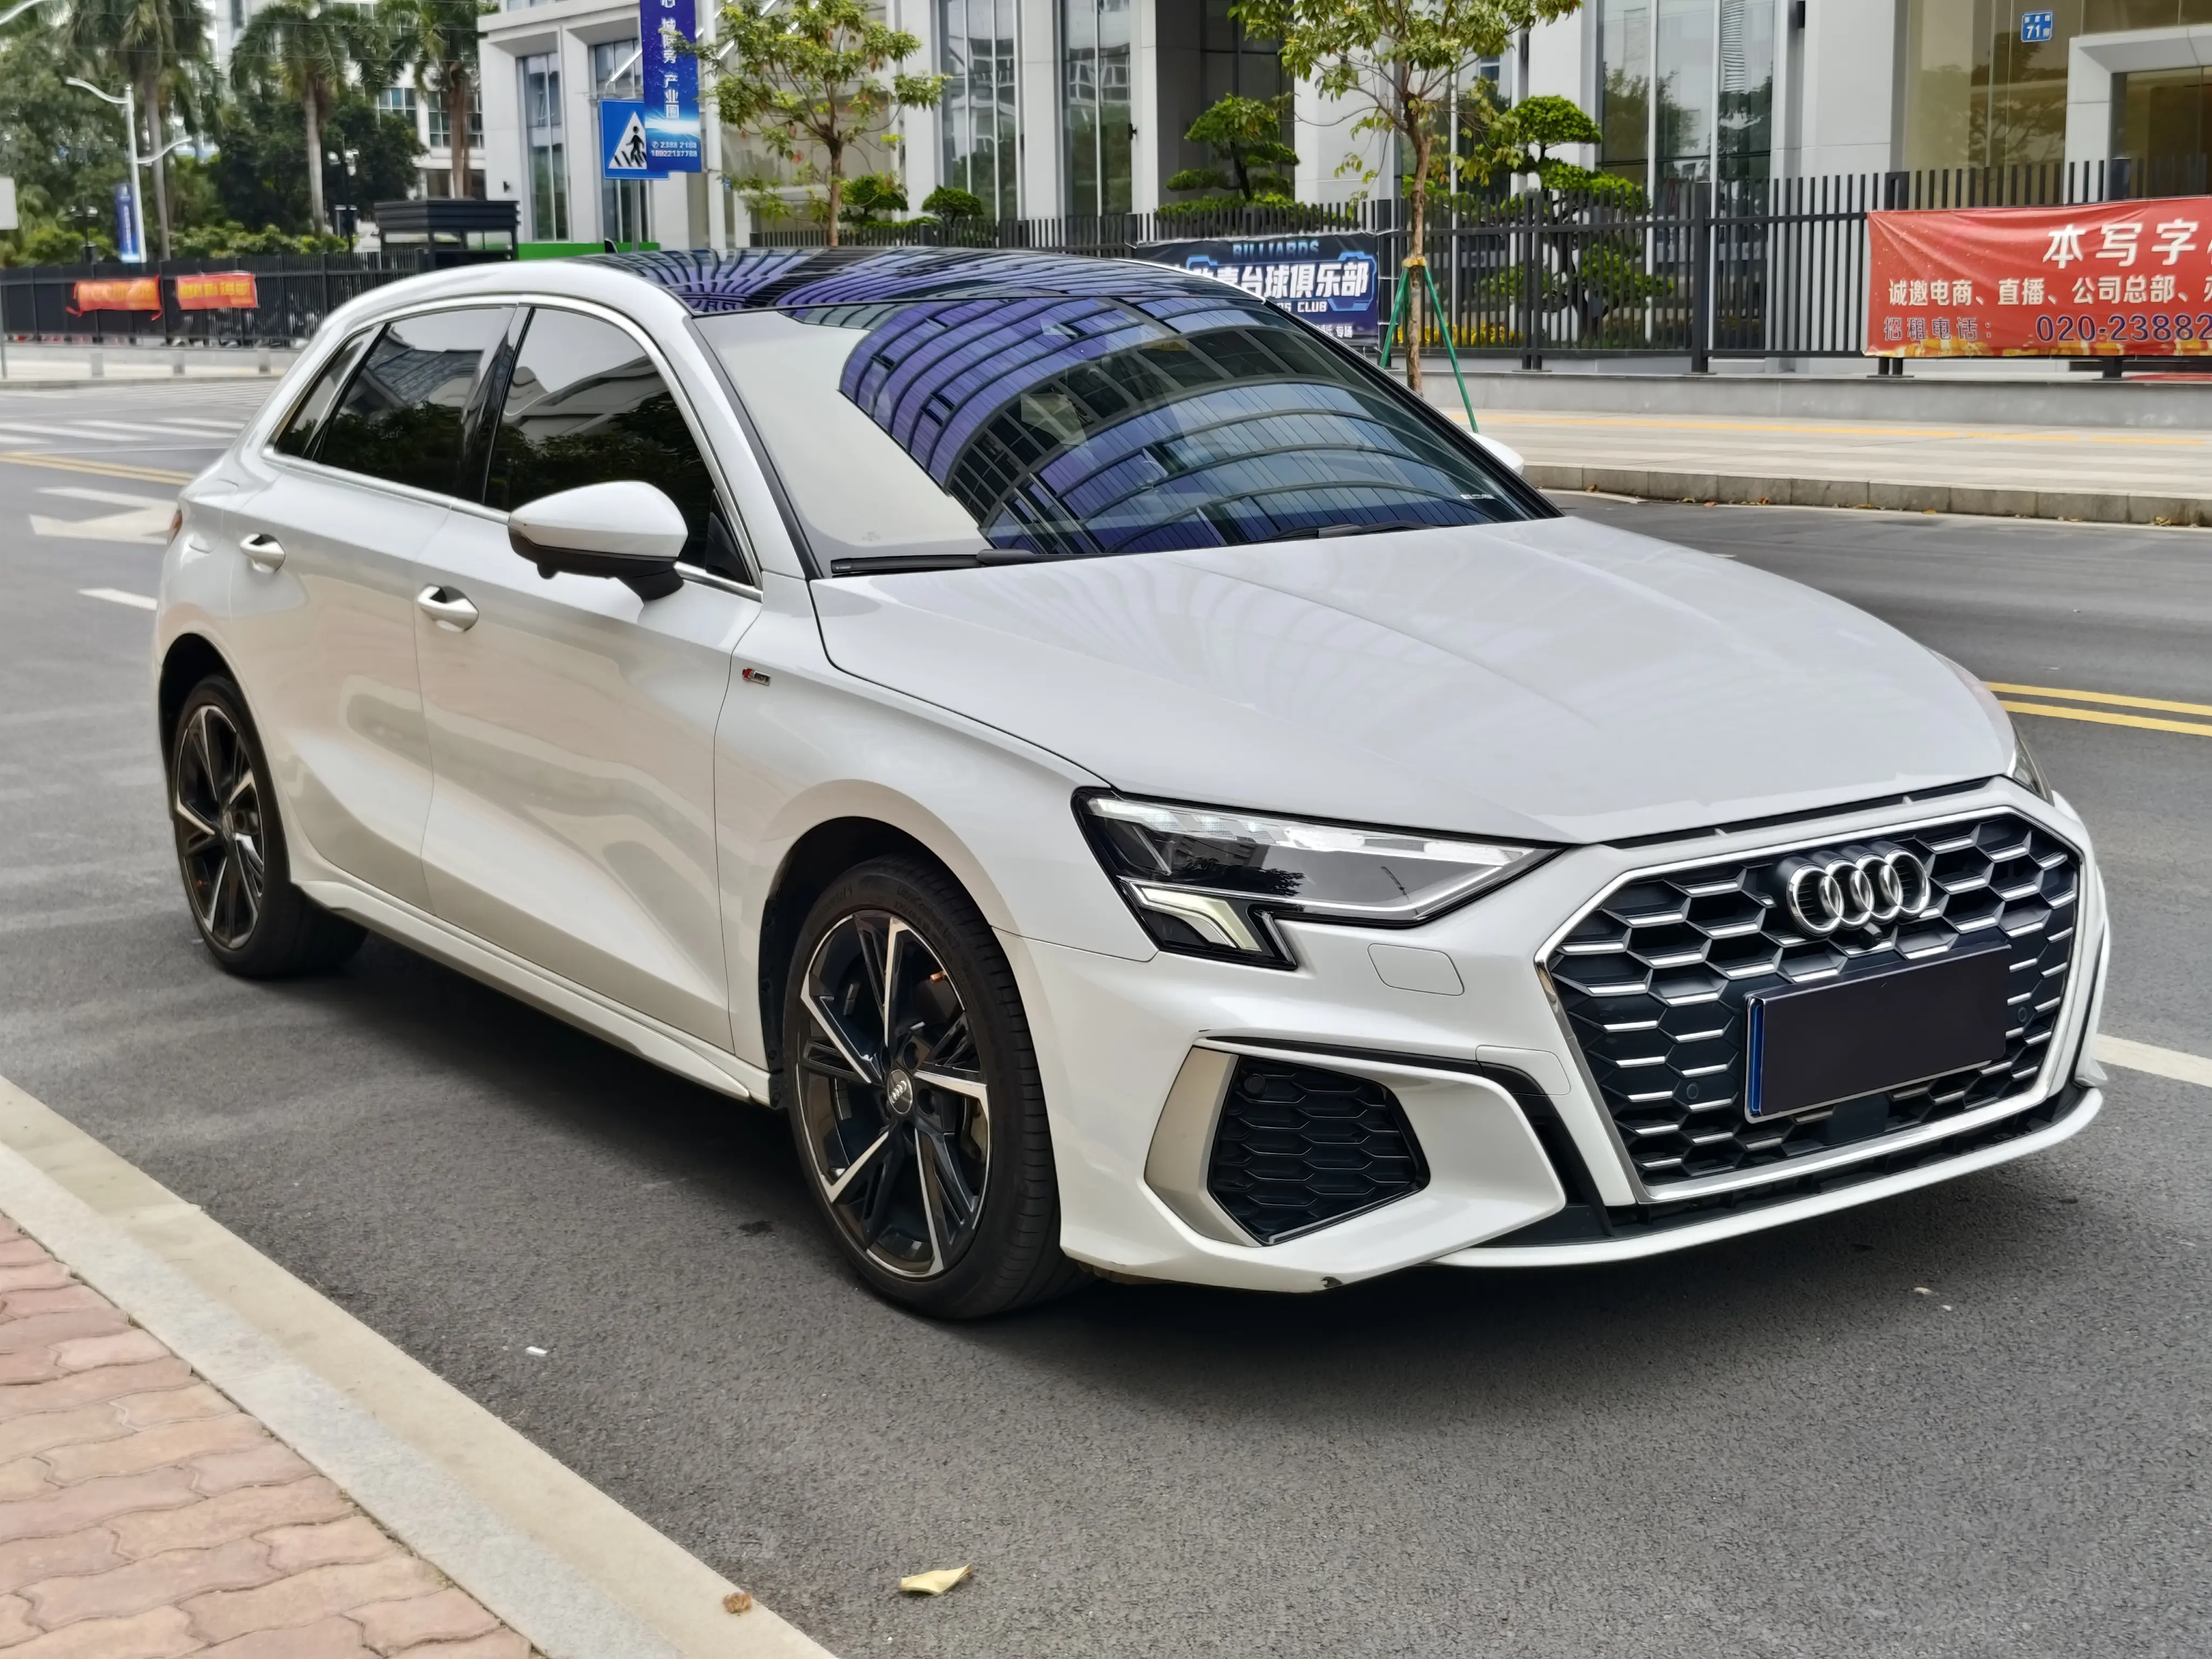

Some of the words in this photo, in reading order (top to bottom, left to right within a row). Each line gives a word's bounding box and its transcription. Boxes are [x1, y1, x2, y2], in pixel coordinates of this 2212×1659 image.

[2026, 24, 2051, 38] 71
[2042, 218, 2212, 268] 本写字
[1297, 301, 1327, 313] CLUB
